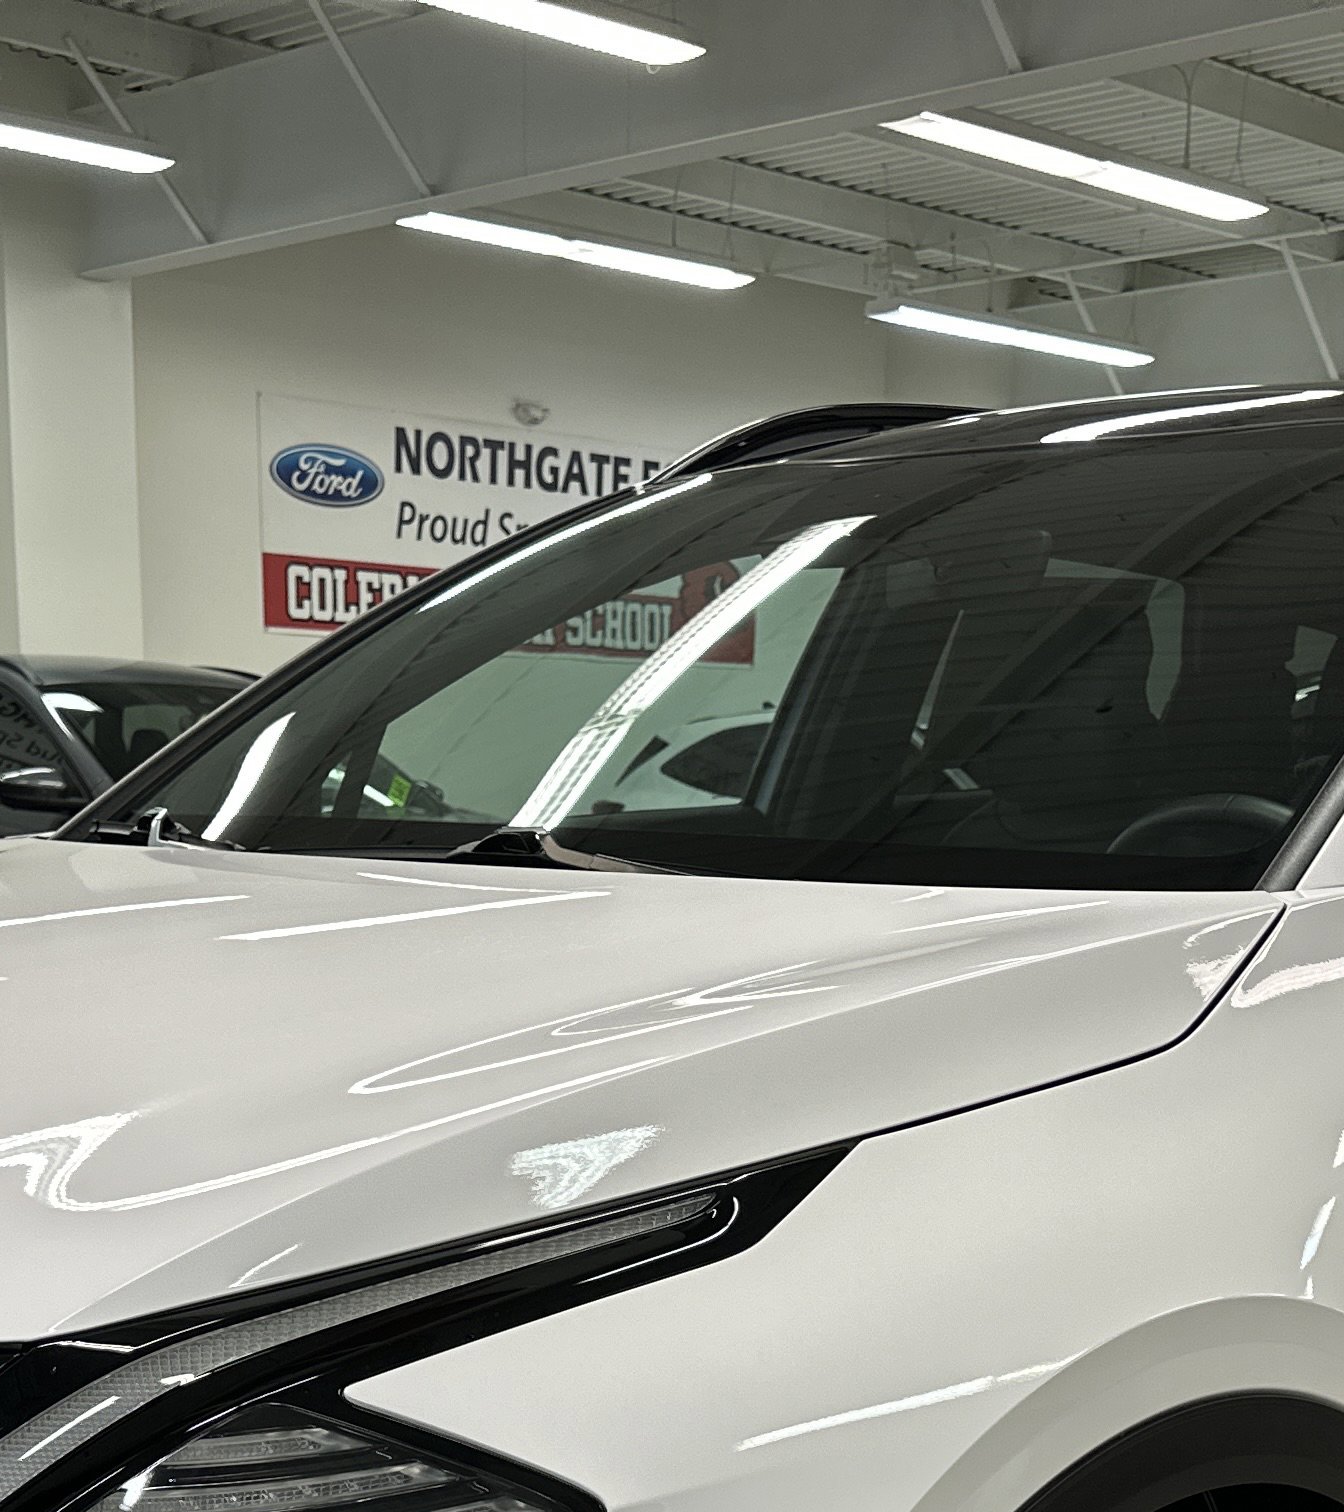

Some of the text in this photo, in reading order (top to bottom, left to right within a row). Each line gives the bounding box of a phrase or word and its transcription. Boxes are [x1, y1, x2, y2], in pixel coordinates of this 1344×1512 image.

[291, 453, 363, 499] Ford
[394, 426, 632, 498] NORTHGATE
[396, 501, 490, 547] Proud
